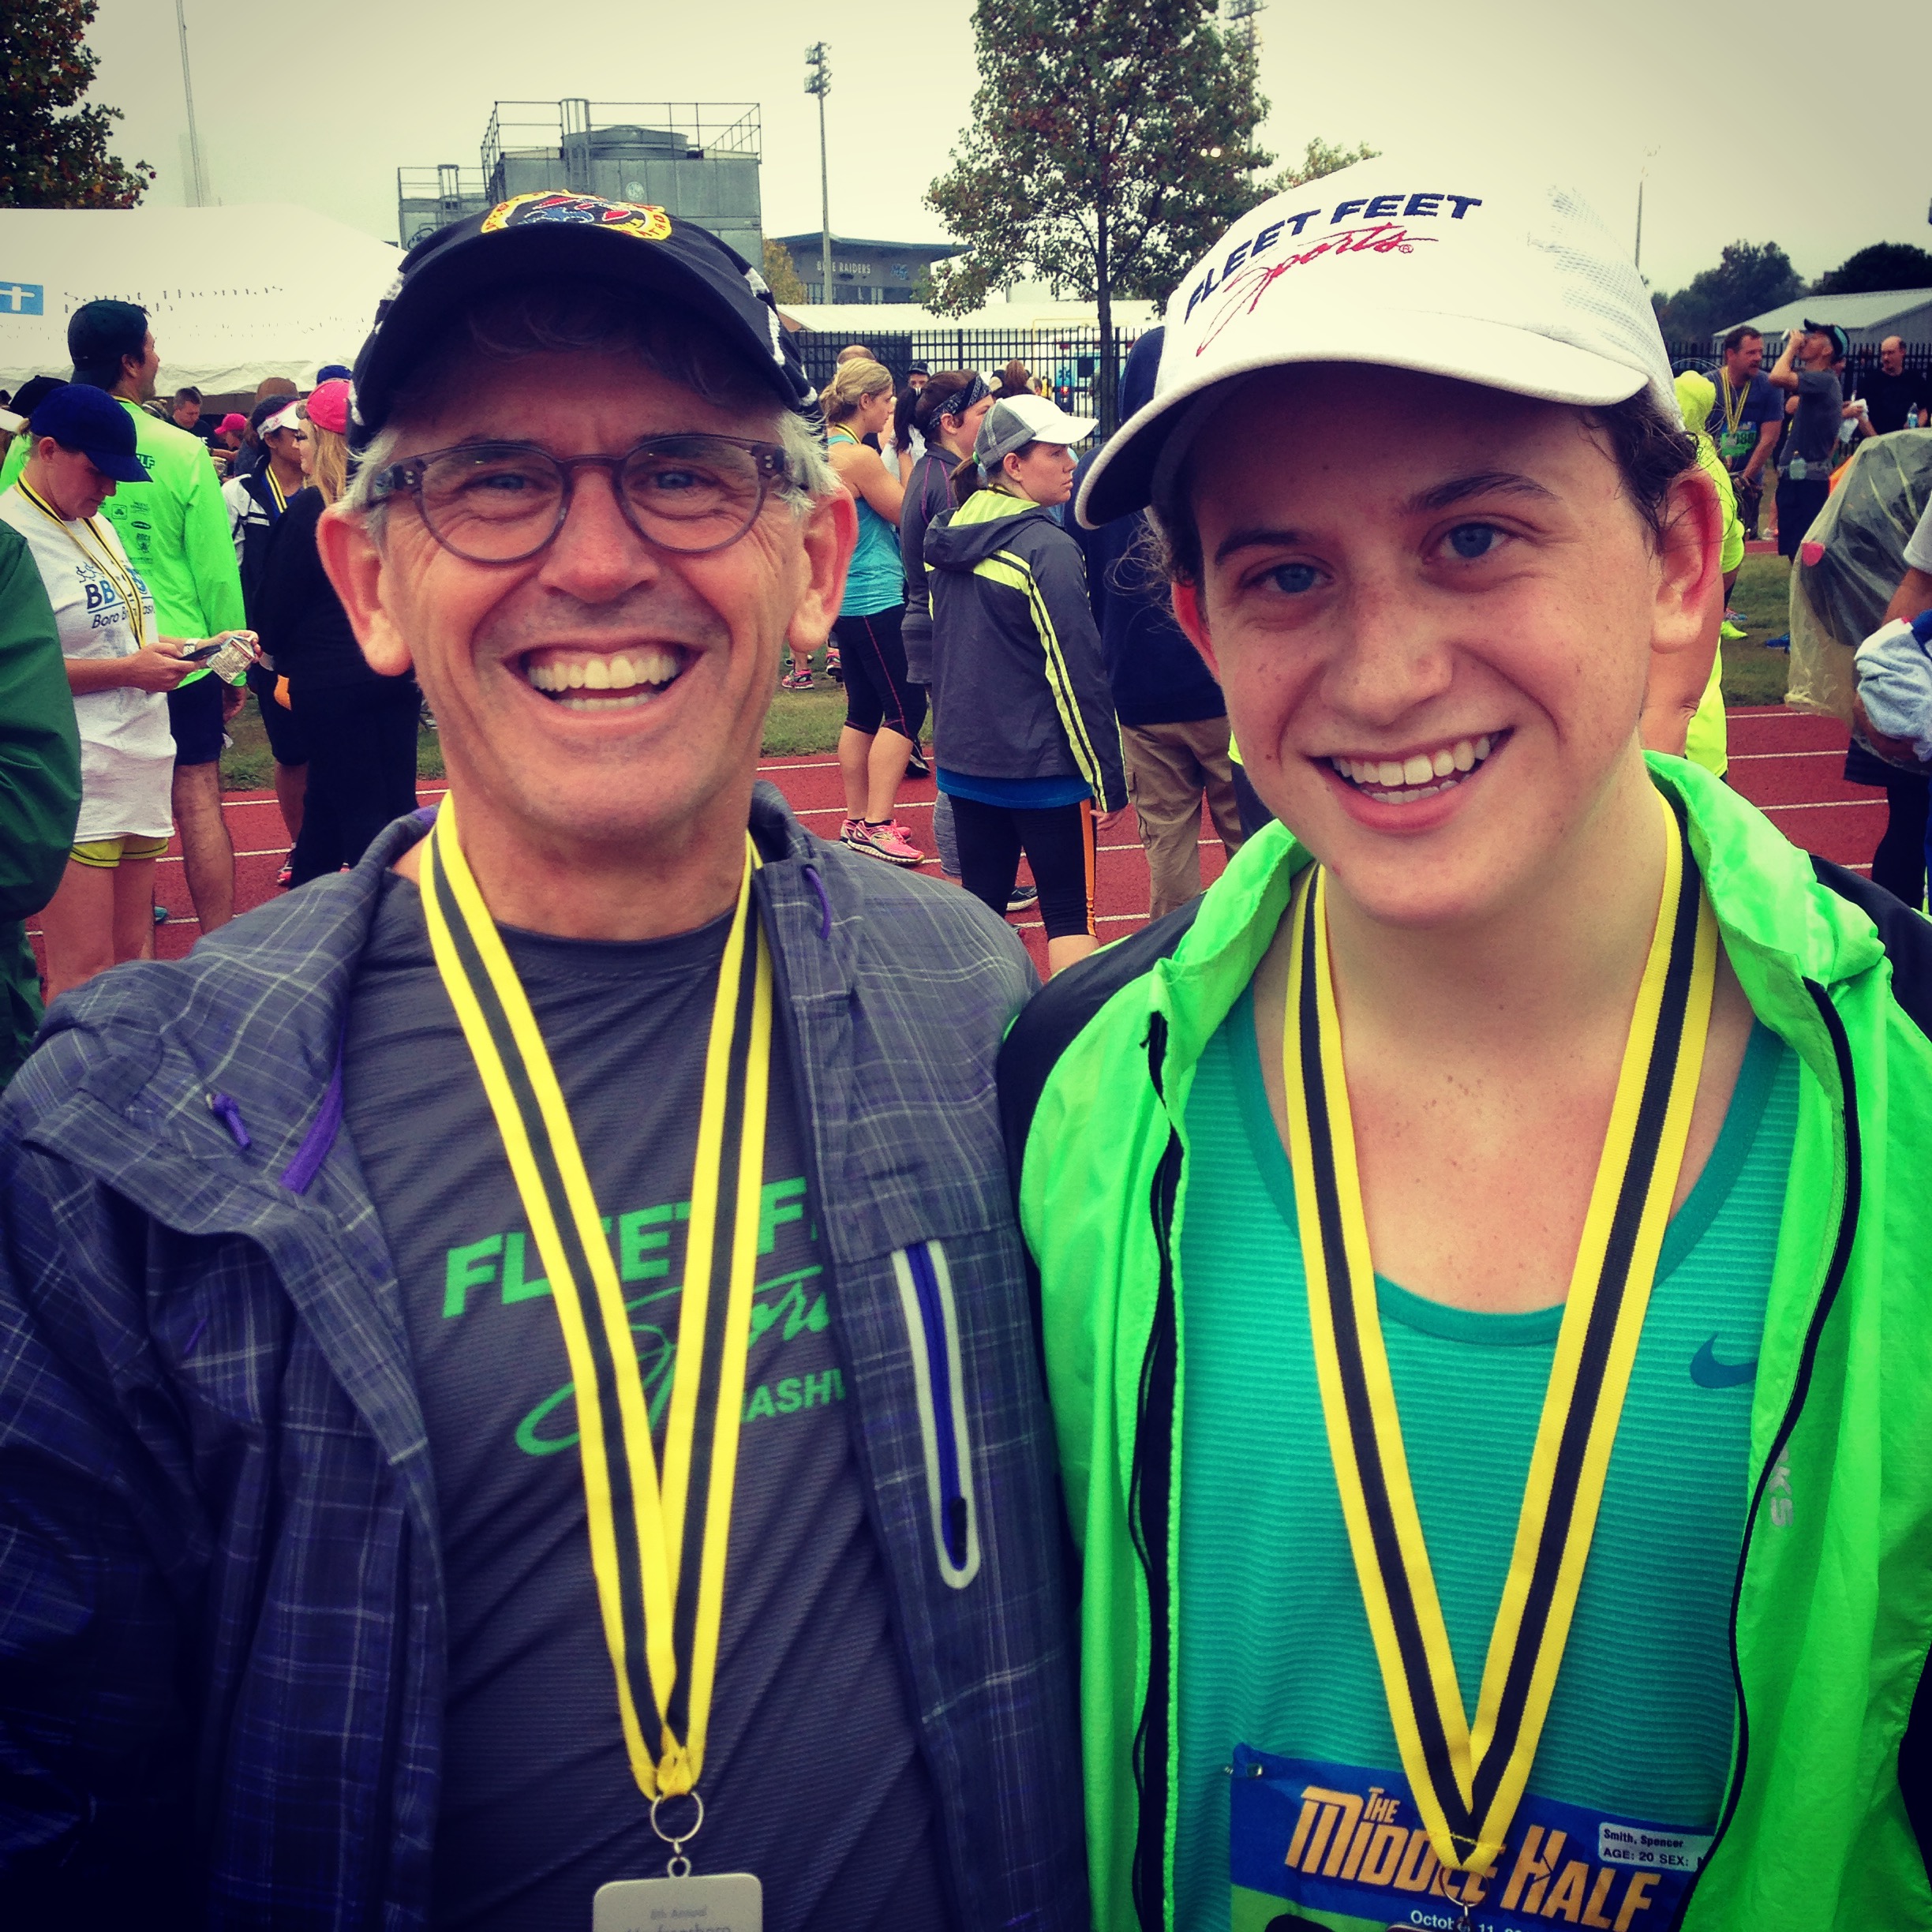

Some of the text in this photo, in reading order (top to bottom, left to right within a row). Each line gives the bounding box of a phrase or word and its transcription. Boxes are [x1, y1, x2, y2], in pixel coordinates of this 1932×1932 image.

[839, 262, 871, 274] RAIDERS
[1184, 193, 1483, 325] FLEET FEET
[92, 612, 120, 629] Boro
[1363, 1787, 1400, 1823] THE
[1640, 1834, 1684, 1848] Spencer
[1603, 1847, 1635, 1861] AGE:
[1638, 1851, 1654, 1863] 20
[1659, 1854, 1689, 1867] SEX:
[1500, 1823, 1662, 1932] HALF
